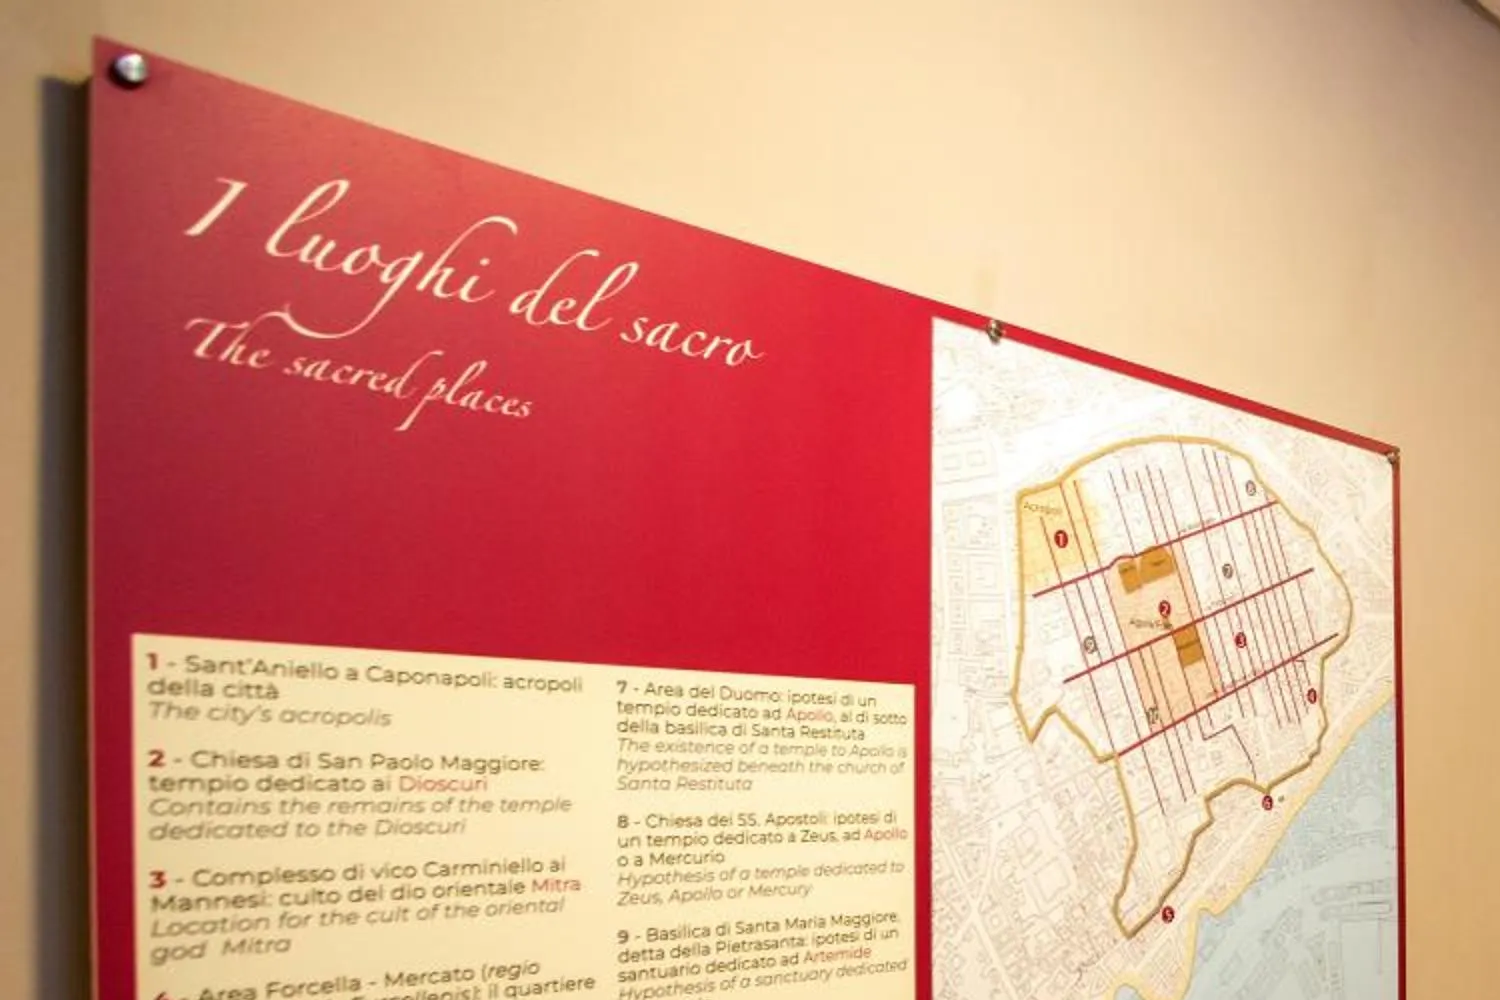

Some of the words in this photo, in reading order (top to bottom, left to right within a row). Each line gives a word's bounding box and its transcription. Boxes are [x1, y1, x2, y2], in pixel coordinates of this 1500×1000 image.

[184, 177, 248, 237] I
[265, 178, 518, 340] luoghi
[508, 249, 641, 332] del
[619, 314, 766, 367] sacro
[184, 312, 275, 369] The
[283, 350, 445, 401] sacred
[393, 360, 534, 433] places
[146, 650, 160, 670] 1
[184, 652, 340, 680] Sant'Aniello
[345, 667, 359, 681] a
[503, 676, 583, 696] acropoli
[146, 675, 214, 697] della
[222, 679, 280, 699] città
[146, 698, 200, 719] The
[206, 701, 273, 726] city's
[277, 709, 392, 730] acropolis
[616, 717, 660, 734] della
[664, 718, 727, 736] basilica
[732, 721, 747, 737] di
[751, 722, 795, 738] Santa
[799, 724, 866, 740] Restituta
[147, 747, 165, 767] 2
[190, 748, 280, 768] Chiesa
[285, 750, 310, 769] di
[317, 751, 363, 769] San
[369, 752, 434, 770] Paolo
[148, 773, 249, 796] tempio
[254, 773, 366, 792] dedicato
[371, 774, 391, 792] ai
[398, 774, 489, 792] Dioscuri
[616, 774, 671, 790] Santa
[675, 774, 753, 790] Restituta
[148, 796, 273, 816] Contains
[278, 796, 321, 814] the
[327, 796, 426, 814] remains
[430, 795, 454, 813] of
[458, 795, 494, 812] the
[499, 795, 572, 815] temple
[148, 819, 289, 840] dedicated
[295, 820, 321, 837] to
[326, 818, 367, 837] the
[373, 817, 467, 836] Dioscuri
[617, 835, 641, 848] un
[646, 830, 709, 850] tempio
[712, 829, 784, 845] dedicato
[787, 832, 796, 843] a
[842, 827, 861, 841] ad
[864, 826, 908, 844] Apollo
[149, 868, 167, 888] 3
[192, 865, 336, 888] Complesso
[342, 862, 365, 880] di
[371, 861, 418, 879] vico
[423, 856, 544, 877] Carminiello
[549, 855, 566, 872] ai
[617, 855, 629, 867] o
[633, 854, 644, 867] a
[648, 848, 728, 866] Mercurio
[278, 886, 342, 906] culto
[347, 883, 385, 903] del
[390, 882, 426, 901] dio
[432, 877, 526, 898] orientale
[531, 876, 581, 893] Mitra
[150, 913, 271, 937] Location
[277, 910, 313, 929] for
[318, 907, 359, 927] the
[365, 904, 410, 924] cult
[416, 902, 440, 921] of
[443, 901, 481, 919] the
[484, 895, 565, 917] oriental
[150, 939, 210, 967] god
[220, 935, 292, 956] Mitra
[618, 960, 701, 983] santuario
[704, 954, 777, 974] dedicato
[779, 950, 799, 966] ad
[803, 944, 874, 964] Artemide
[265, 974, 361, 999] Forcella
[384, 966, 475, 989] Mercato
